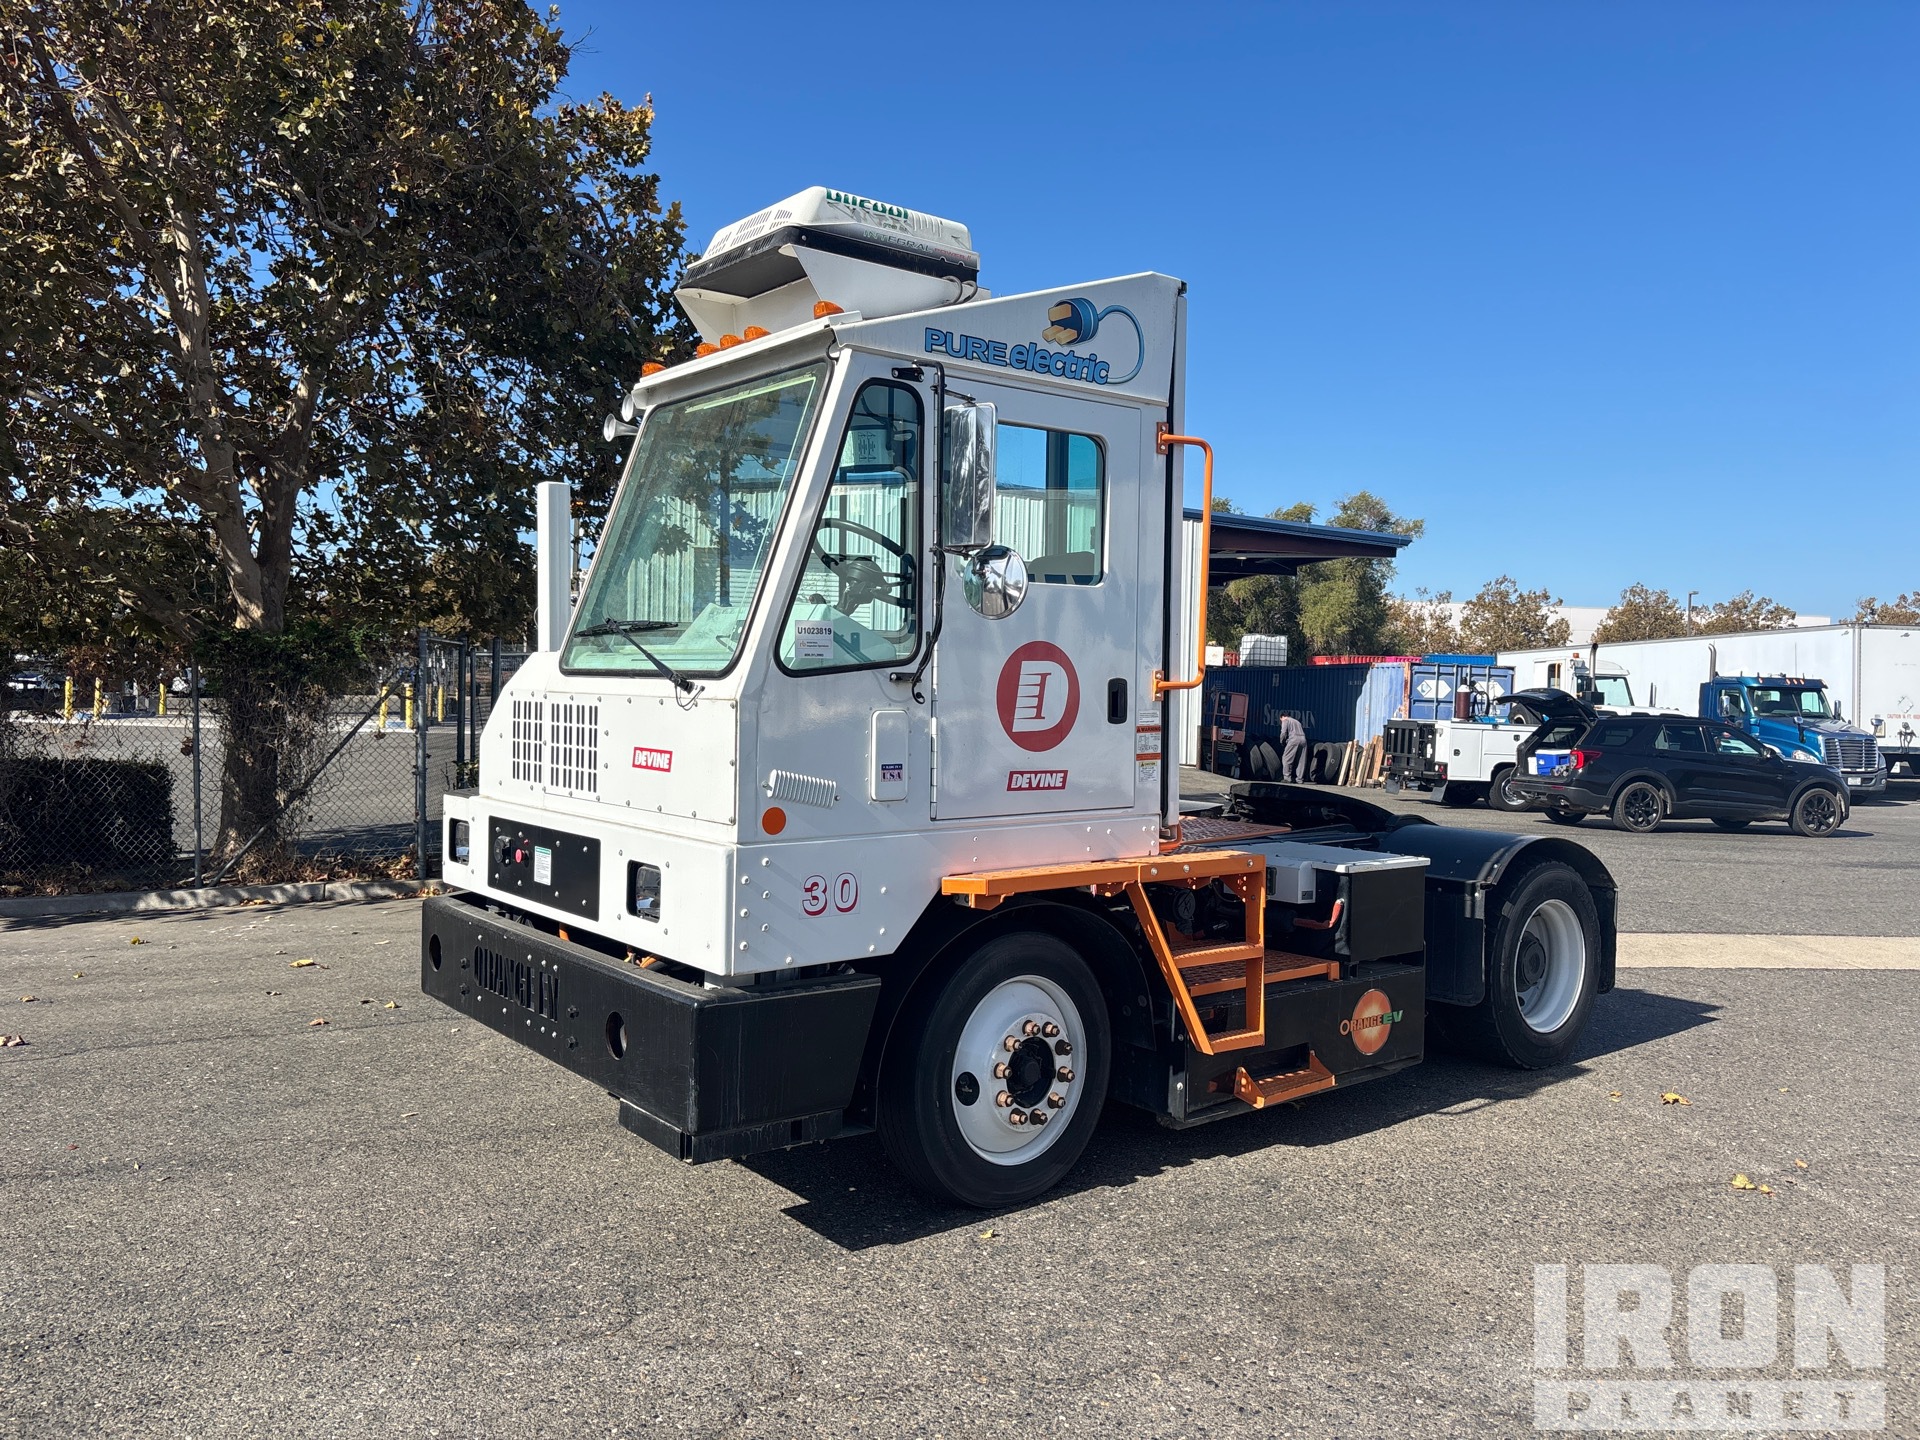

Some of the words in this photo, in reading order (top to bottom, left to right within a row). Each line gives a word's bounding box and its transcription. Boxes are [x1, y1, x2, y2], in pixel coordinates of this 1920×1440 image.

[863, 229, 933, 254] INTEGRAL
[925, 327, 1008, 367] PURE
[1009, 342, 1110, 385] electric
[797, 626, 832, 636] U1023819
[634, 748, 671, 770] DEVINE
[882, 771, 902, 779] USA
[1011, 773, 1064, 789] DEVINE
[803, 872, 858, 916] 30
[474, 945, 535, 1013] ORANGE
[539, 971, 560, 1023] EV
